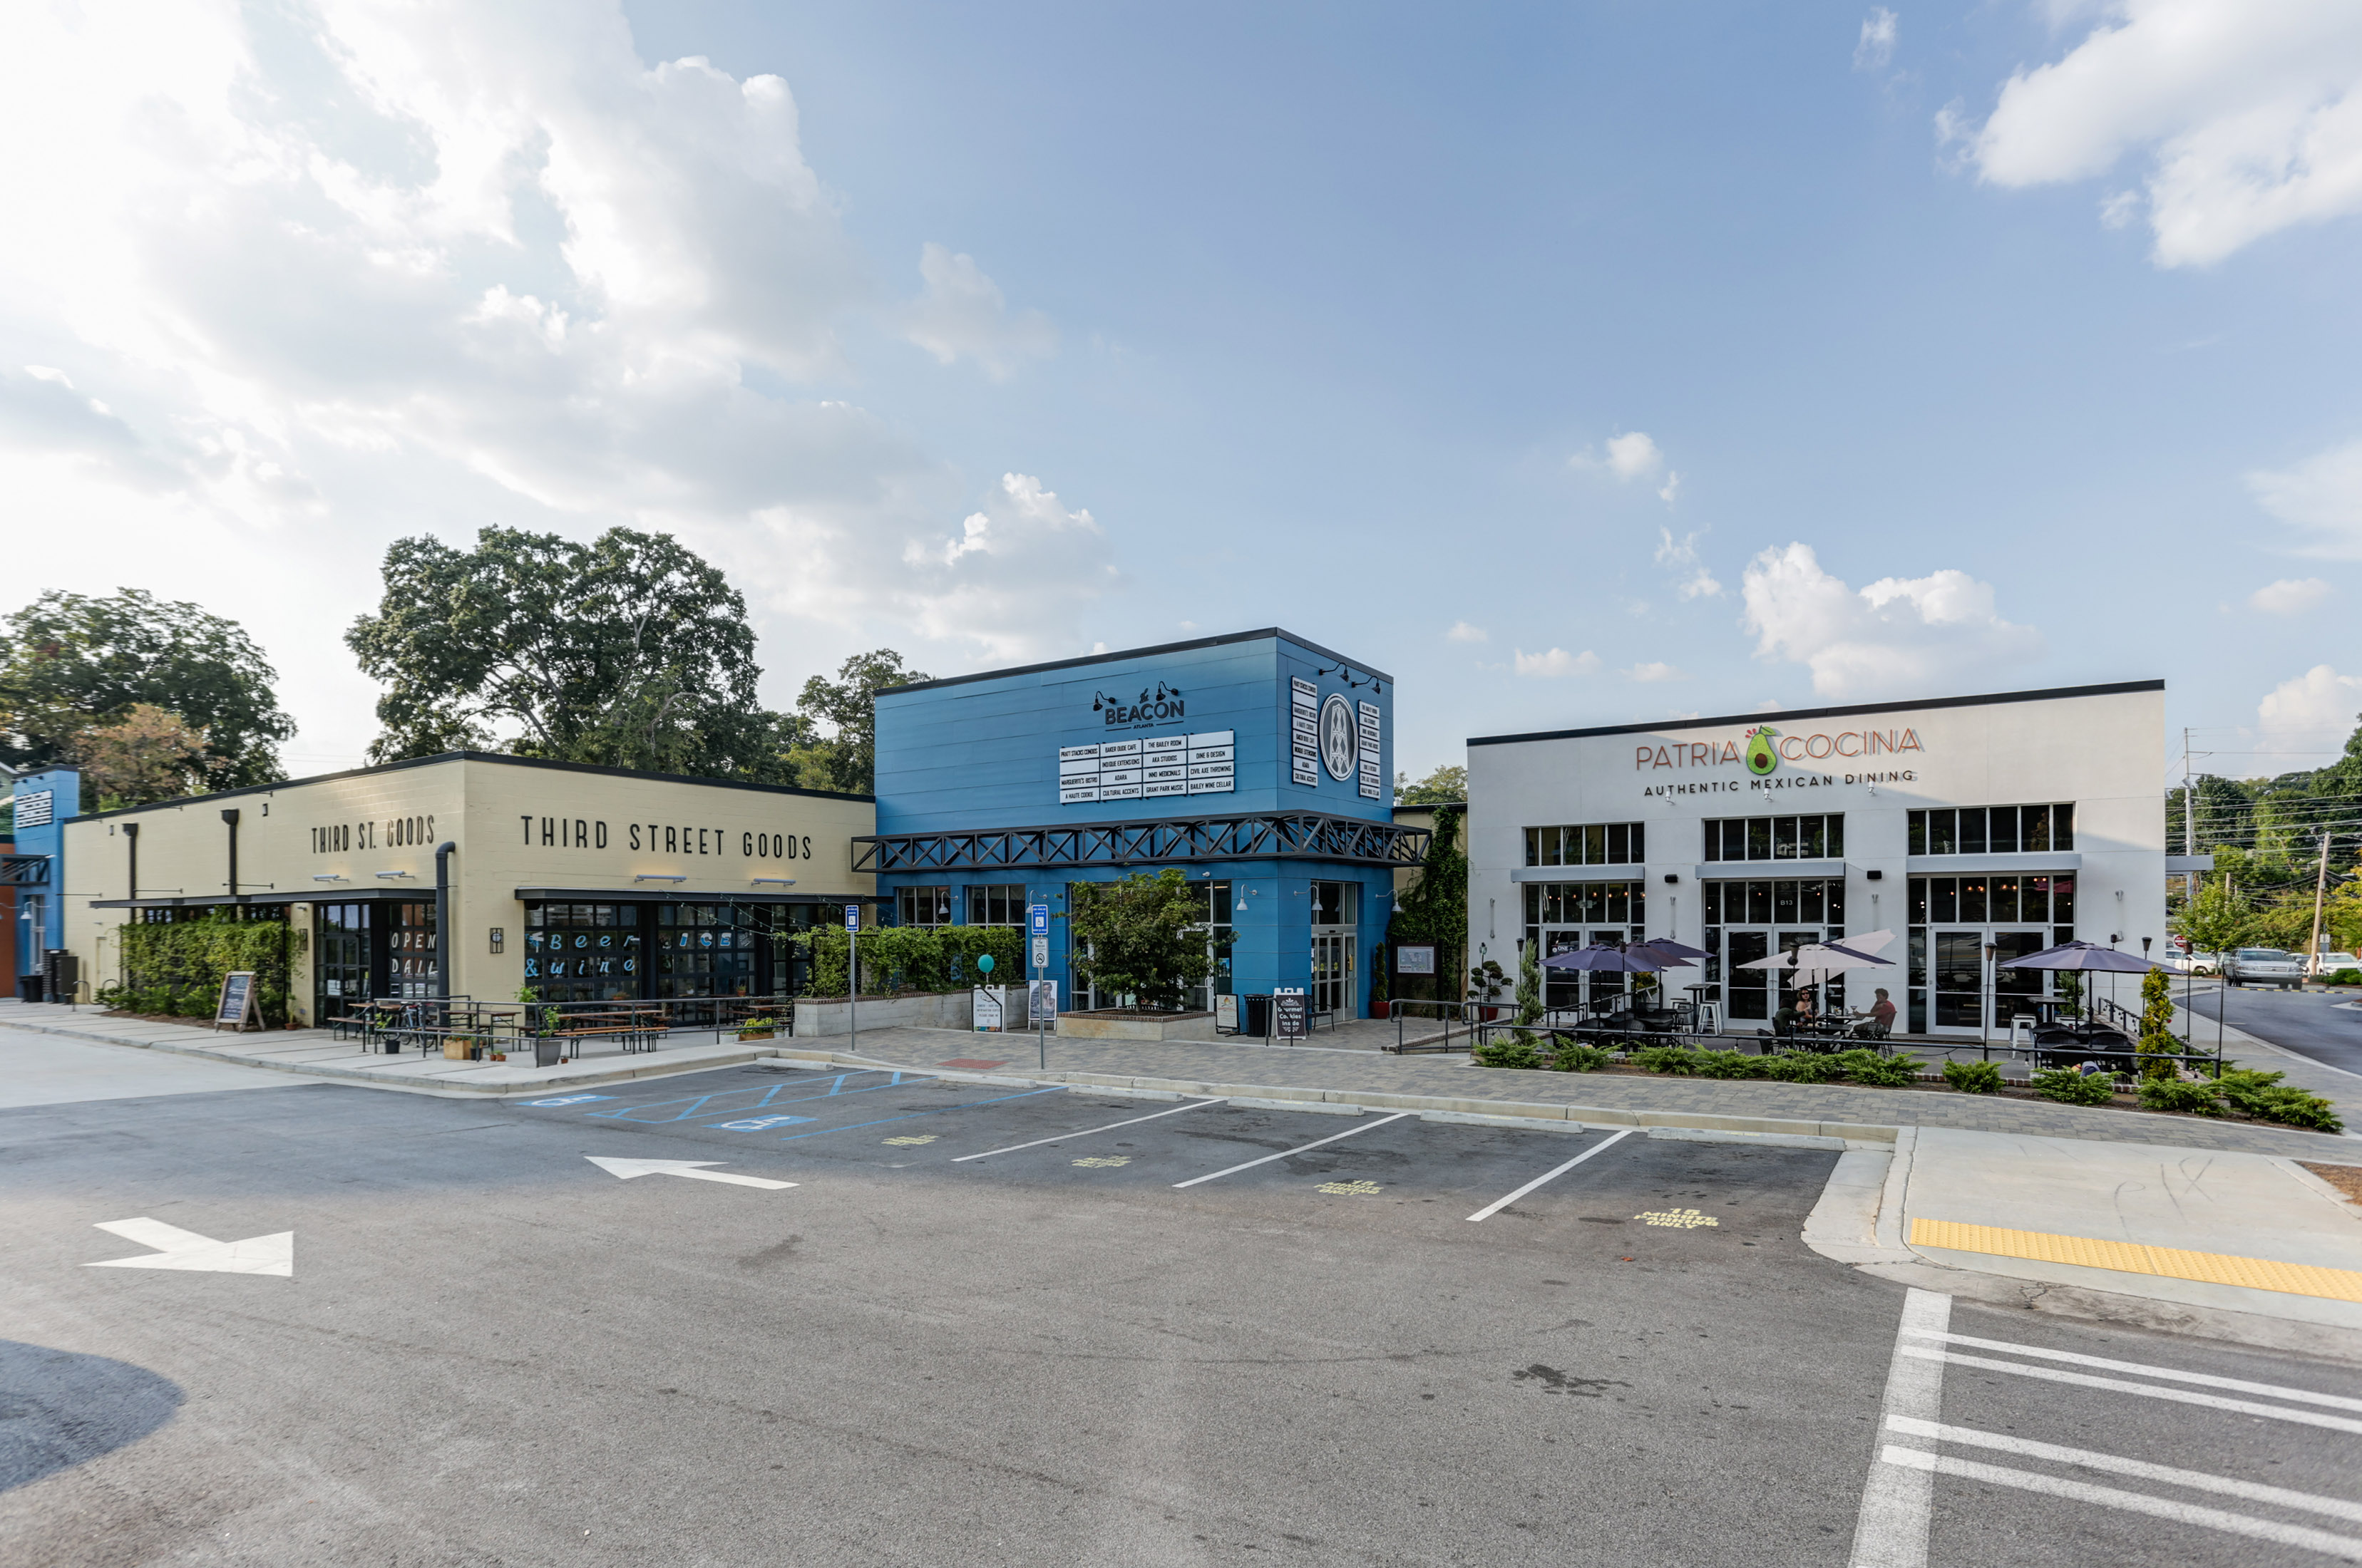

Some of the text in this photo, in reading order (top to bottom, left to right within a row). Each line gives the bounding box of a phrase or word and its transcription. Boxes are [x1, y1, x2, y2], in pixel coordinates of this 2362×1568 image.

[1105, 700, 1184, 725] BEACON
[1637, 728, 1921, 770] PATRIA COCINA
[1644, 770, 1913, 796] AUTHENTIC MEXICAN DINING
[312, 815, 434, 854] THIRD ST. GOODS
[520, 815, 811, 860] THIRD STREET GOODS
[391, 932, 436, 949] OPEN
[549, 934, 635, 950] Beer
[679, 932, 732, 947] ICE
[391, 958, 438, 975] DAIL
[525, 958, 635, 977] & wine
[1633, 1214, 1720, 1227] PARKING
[1642, 1211, 1717, 1222] MINUTE
[1646, 1220, 1698, 1229] ONLY
